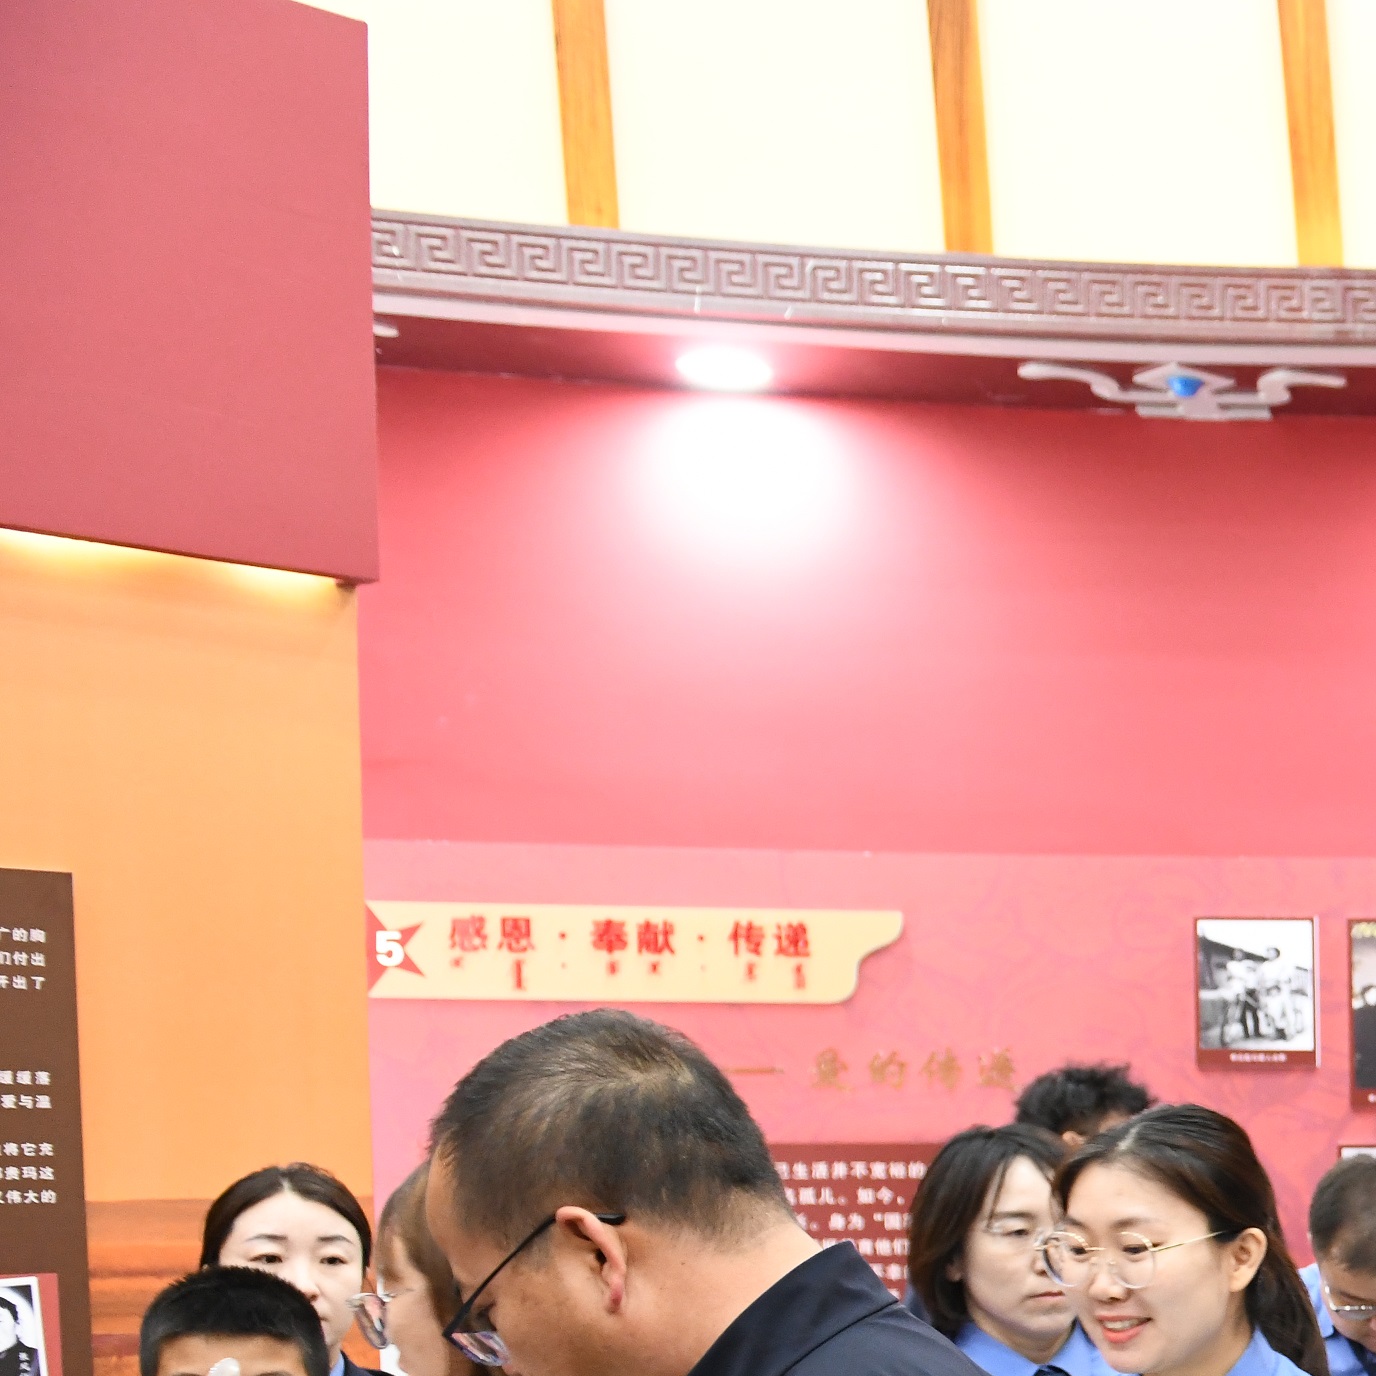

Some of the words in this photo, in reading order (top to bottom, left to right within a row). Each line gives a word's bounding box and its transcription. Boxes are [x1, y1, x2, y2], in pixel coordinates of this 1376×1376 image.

[375, 931, 405, 966] 5
[449, 914, 811, 958] 感恩·奉献·传递
[0, 1142, 54, 1156] 将它充
[0, 1166, 55, 1180] 贵玛这
[0, 1189, 57, 1204] 伟大的
